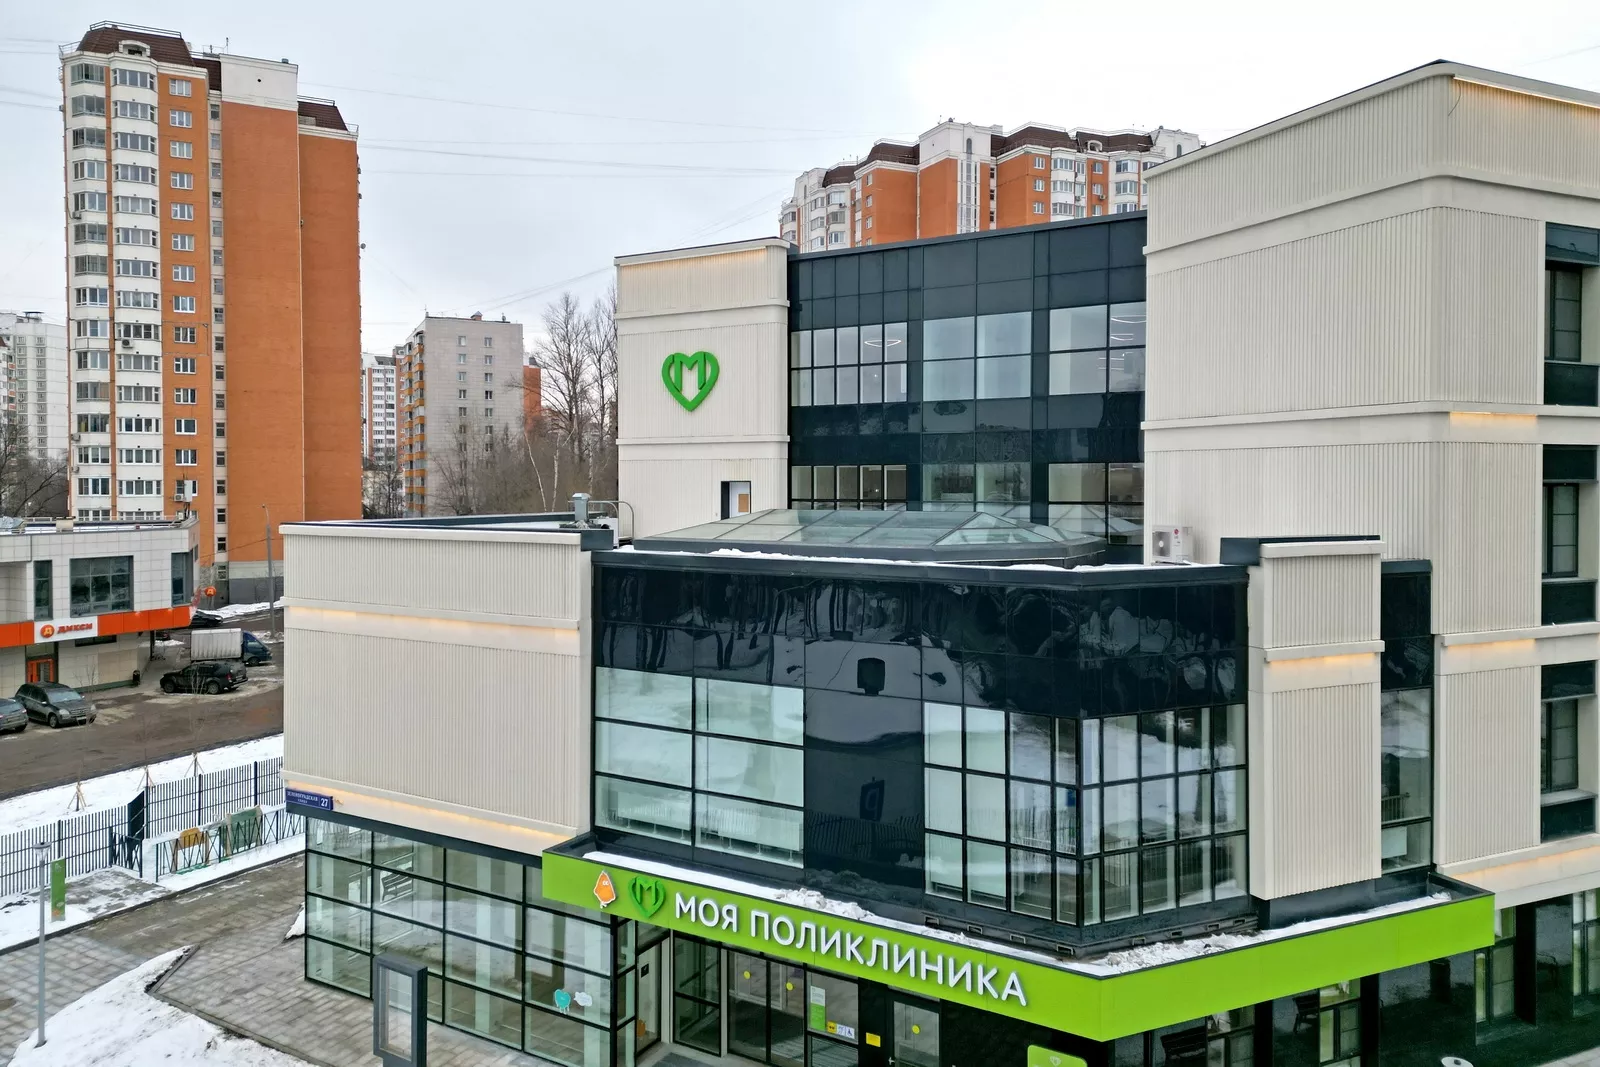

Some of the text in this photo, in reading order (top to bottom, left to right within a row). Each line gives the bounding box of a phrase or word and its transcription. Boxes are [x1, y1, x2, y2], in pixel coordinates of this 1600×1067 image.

[320, 798, 328, 807] 27
[675, 892, 1027, 1007] МОЯ ПОЛИКЛИНИКА
